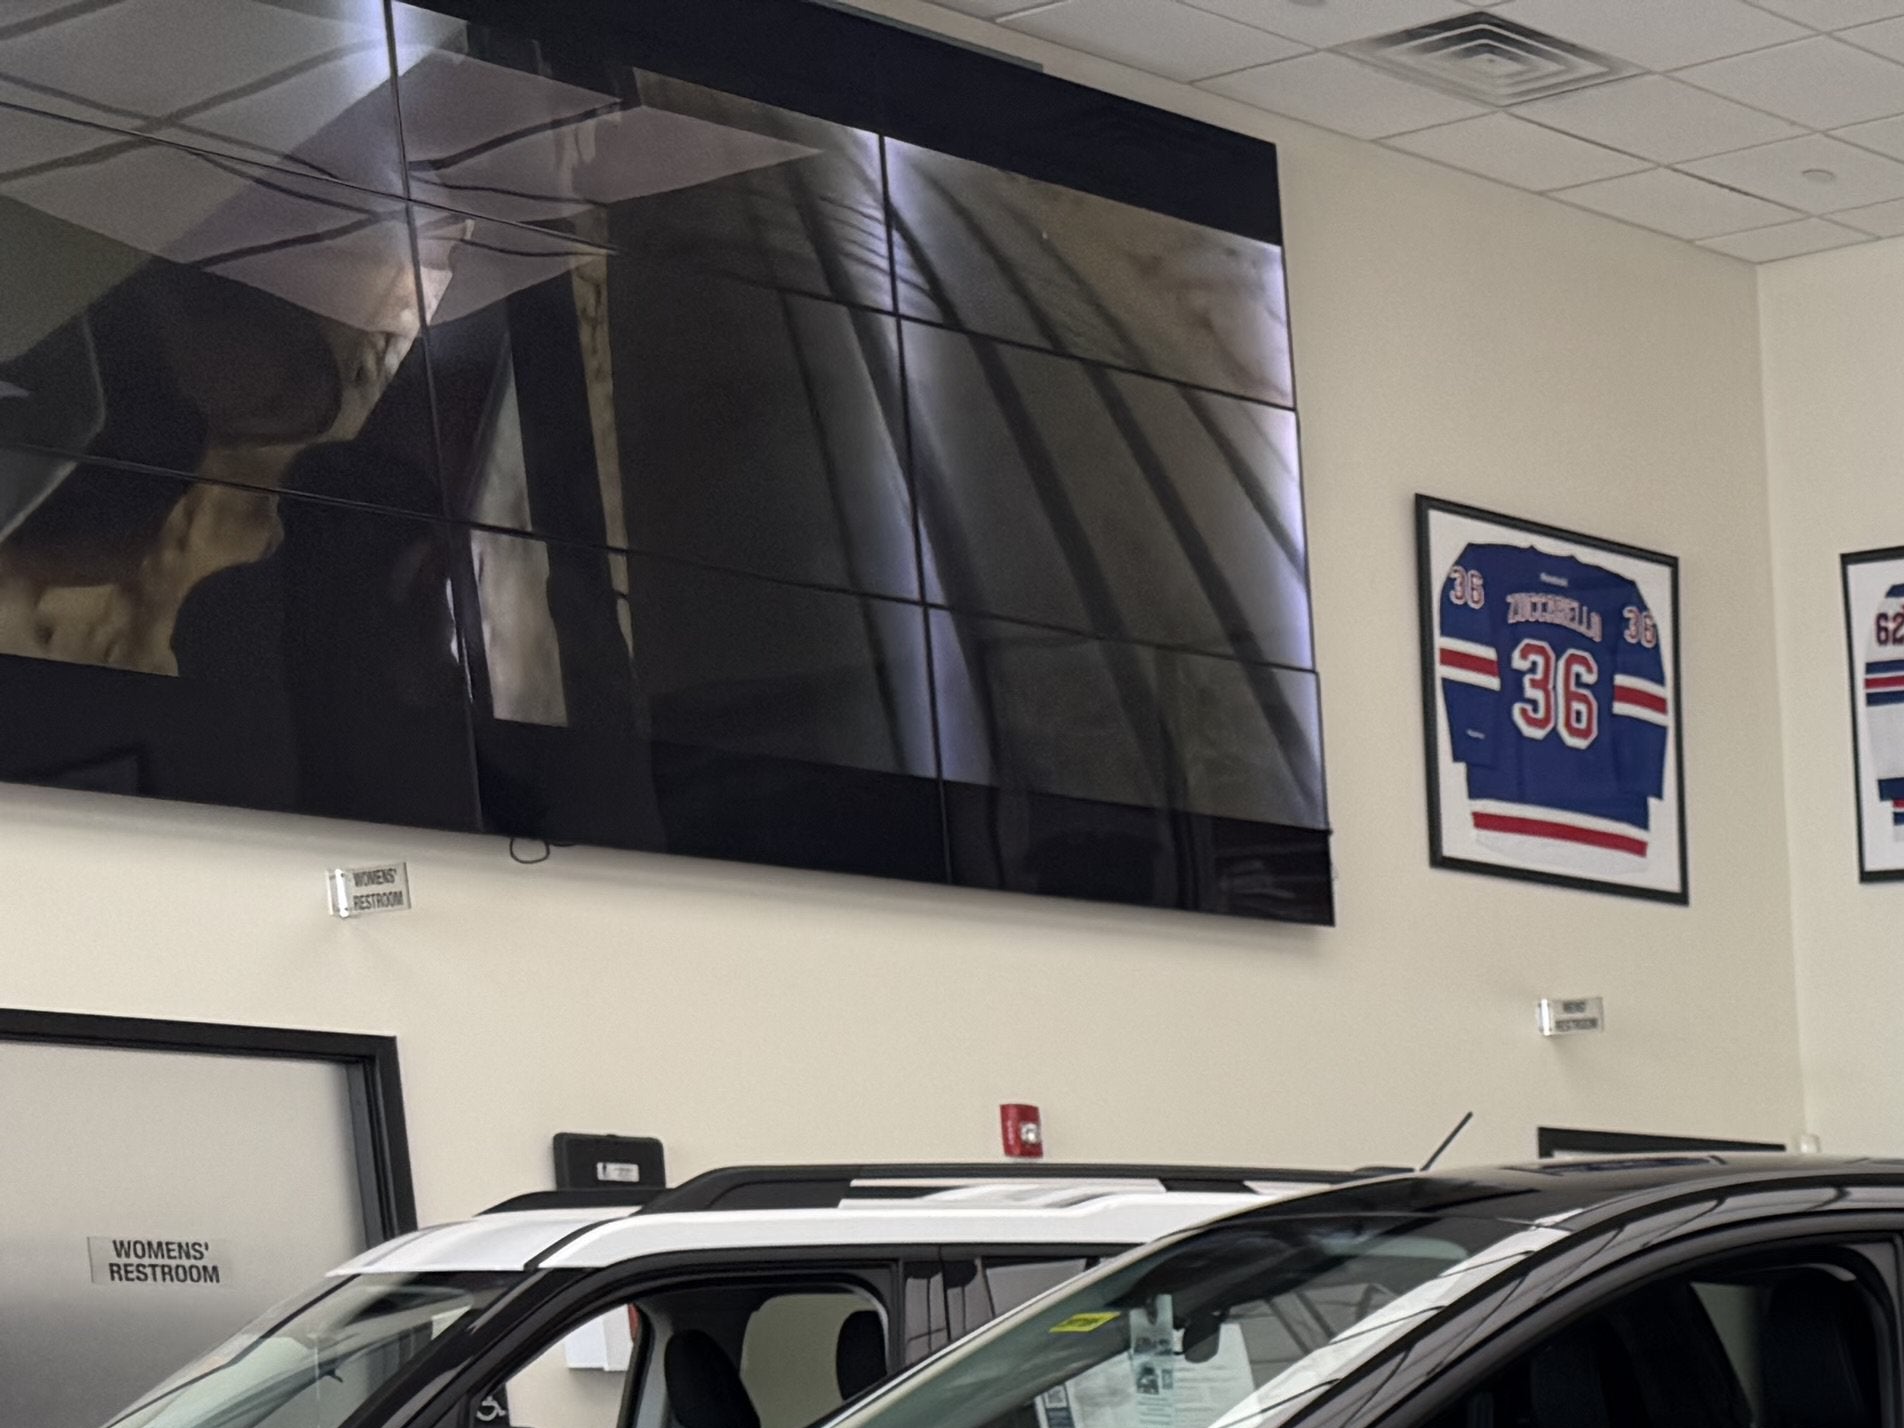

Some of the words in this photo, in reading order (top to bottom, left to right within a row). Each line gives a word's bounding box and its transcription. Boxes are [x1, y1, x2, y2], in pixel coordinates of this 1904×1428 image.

[1449, 565, 1486, 610] 36
[1623, 605, 1658, 648] 36
[1511, 638, 1599, 750] 36
[352, 890, 404, 912] RESTROOM
[112, 1239, 210, 1261] WOMENS'
[108, 1262, 221, 1284] RESTROOM
